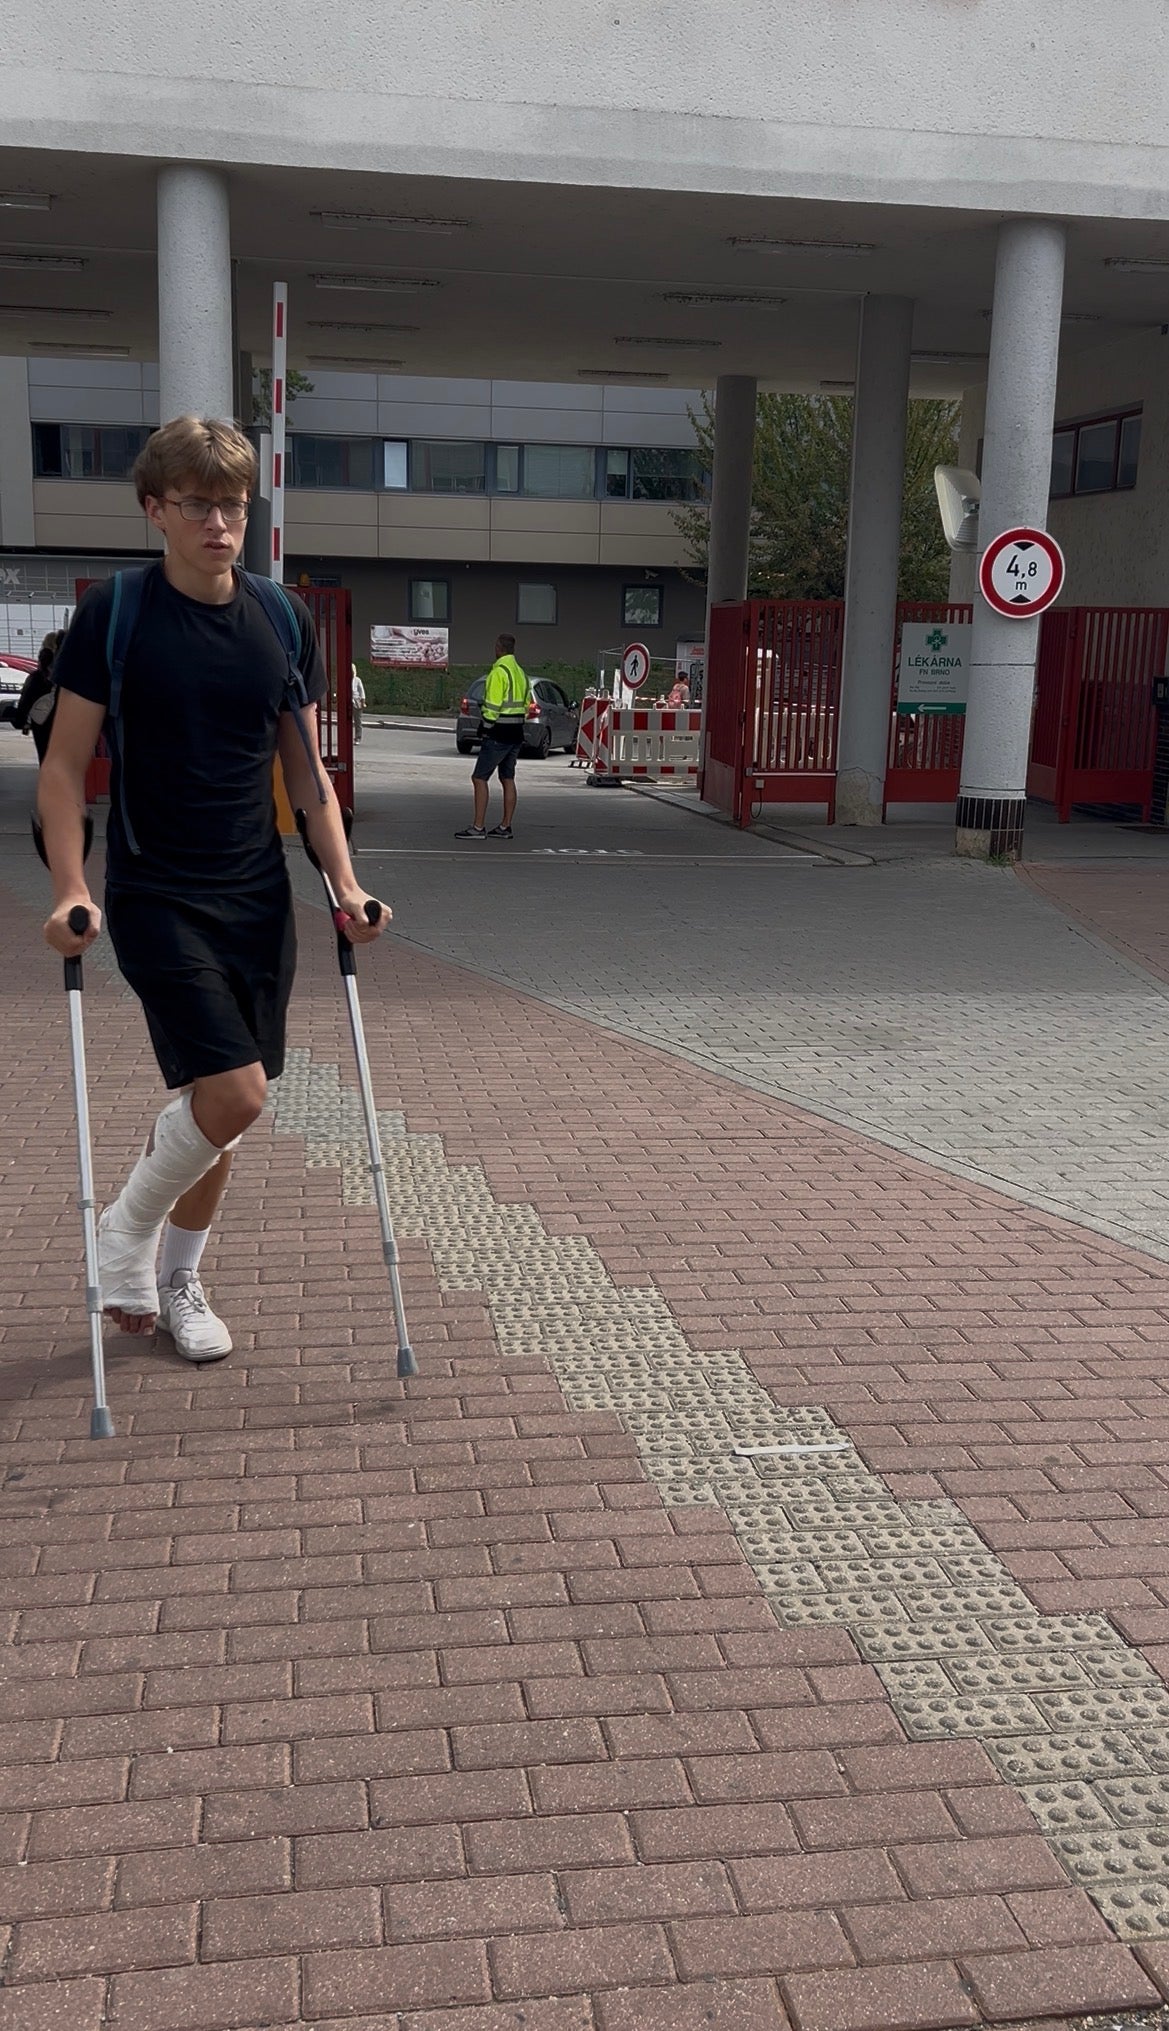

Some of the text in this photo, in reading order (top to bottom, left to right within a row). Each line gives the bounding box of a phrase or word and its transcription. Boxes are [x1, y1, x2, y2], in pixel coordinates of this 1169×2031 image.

[1006, 555, 1038, 579] 4,8
[1015, 581, 1027, 590] m
[907, 654, 962, 667] LÉKÁRNA
